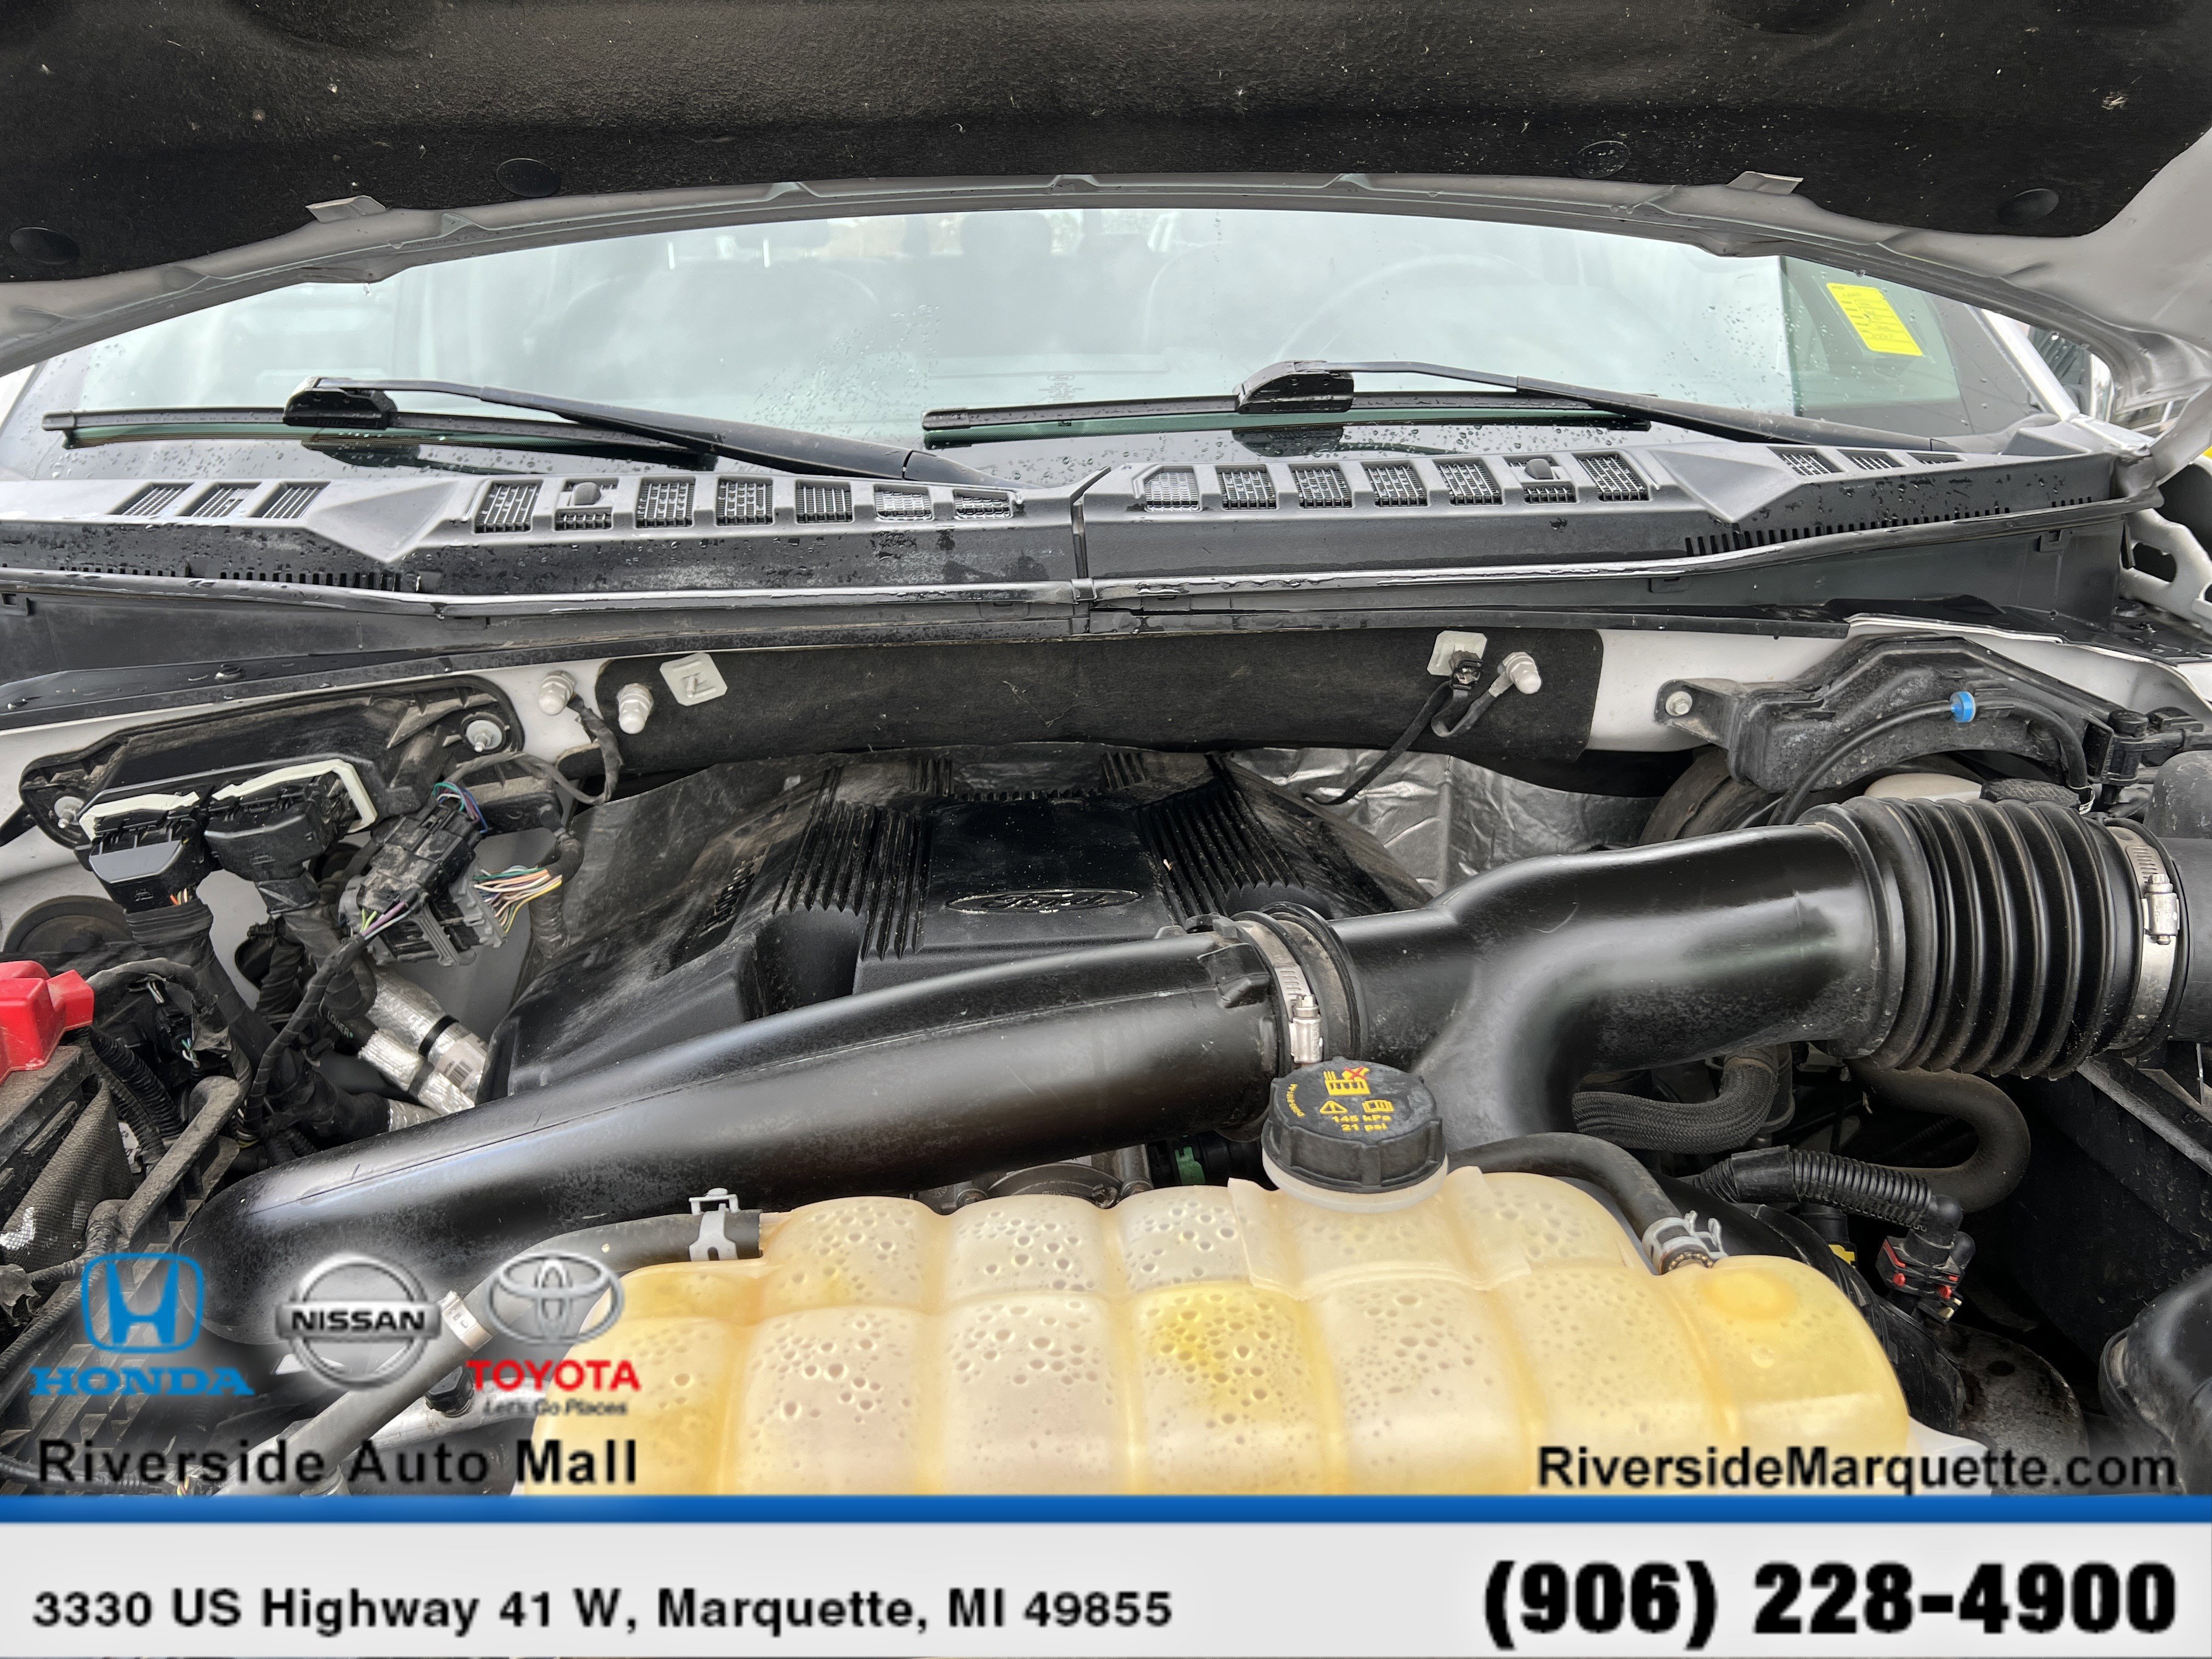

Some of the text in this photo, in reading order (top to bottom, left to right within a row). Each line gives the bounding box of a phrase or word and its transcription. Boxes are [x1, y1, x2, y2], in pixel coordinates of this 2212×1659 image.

[981, 891, 1107, 909] Ford
[327, 1010, 349, 1038] LOWER
[1331, 1115, 1359, 1123] 145
[1341, 1122, 1387, 1132] 21 psi
